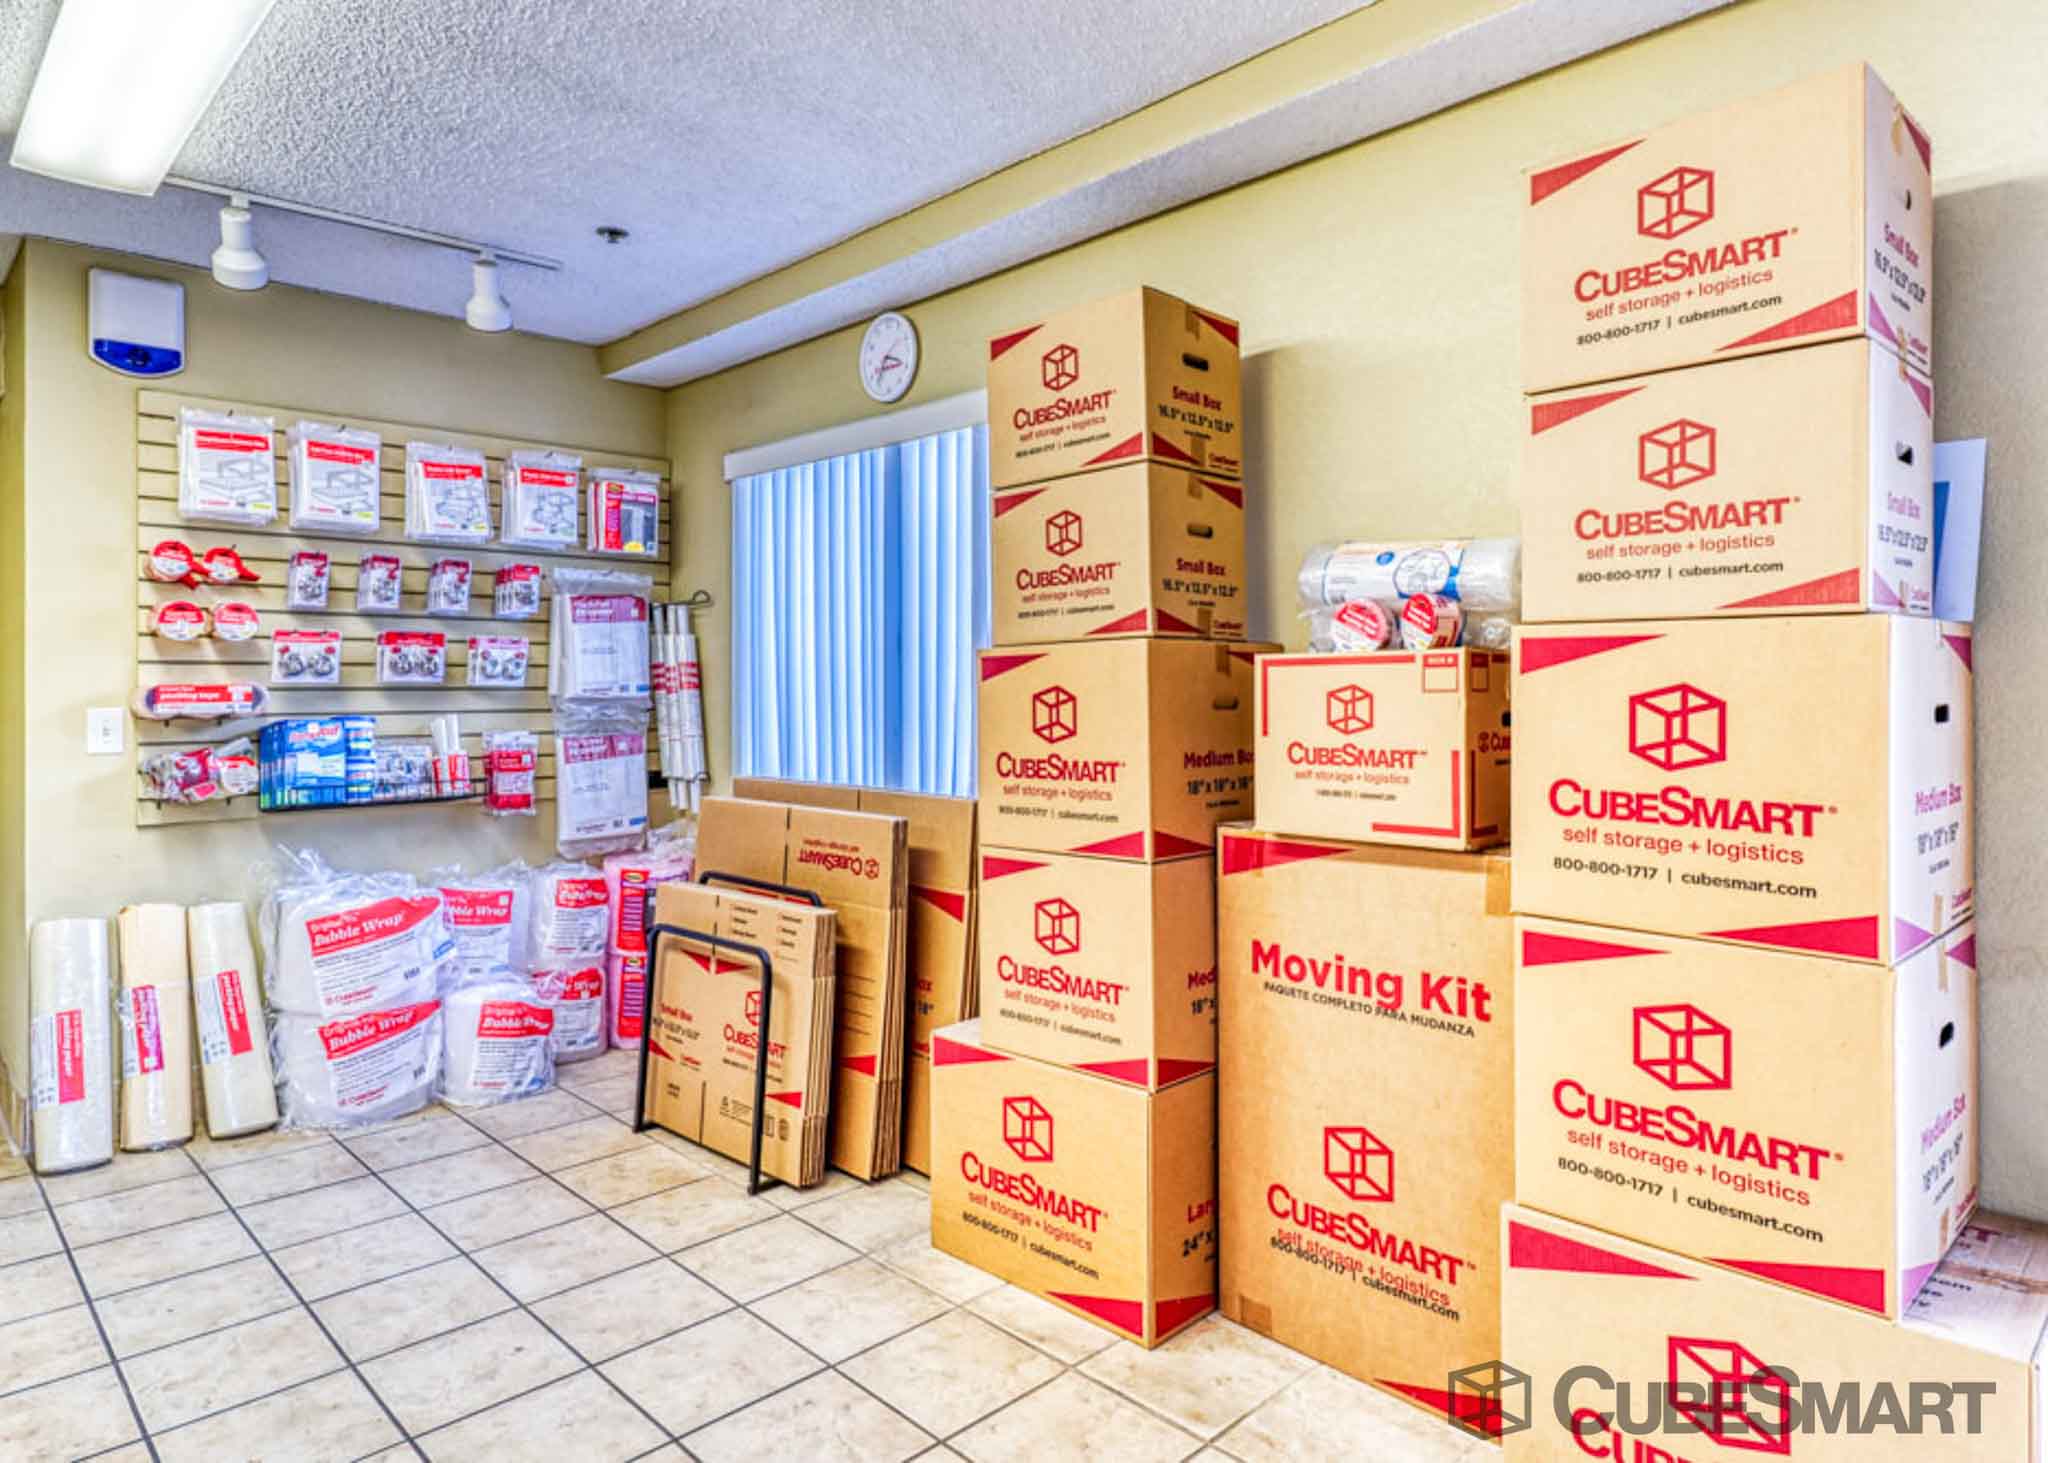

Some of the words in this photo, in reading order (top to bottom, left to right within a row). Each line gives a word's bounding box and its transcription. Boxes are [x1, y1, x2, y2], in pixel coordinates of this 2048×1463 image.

[1586, 293, 1614, 321] self
[1618, 287, 1680, 317] storage
[1699, 268, 1773, 298] logistics
[1577, 318, 1660, 345] 800-800-1717
[1678, 294, 1782, 325] cubesmart.com
[1172, 385, 1200, 405] Small
[1176, 557, 1204, 573] Small
[1586, 544, 1614, 560] self
[1618, 540, 1682, 560] storage
[1699, 533, 1775, 556] logistics
[1577, 567, 1661, 583] 800-800-1717
[1679, 560, 1783, 578] cubesmart.com
[1021, 785, 1059, 801] storage
[1069, 786, 1112, 803] logistics
[1563, 826, 1598, 844] self
[1603, 830, 1683, 854] storage
[1705, 838, 1804, 866] logistics
[1553, 856, 1657, 881] 800-800-1717
[1681, 870, 1817, 899] cubesmart.com
[315, 925, 360, 946] Bubble
[362, 911, 404, 932] Wrap
[1251, 939, 1404, 1011] Moving
[1420, 971, 1492, 1023] Kit
[1023, 993, 1060, 1011] storage
[1071, 1003, 1116, 1023] logistics
[1263, 980, 1310, 1001] PAQUETE
[1312, 992, 1373, 1016] COMPLETO
[1375, 1006, 1408, 1023] PARA
[1410, 1015, 1475, 1038] MUDANZA
[330, 1022, 376, 1050] Bubble
[1567, 1127, 1602, 1151] self
[1608, 1138, 1688, 1174] storage
[1712, 1167, 1811, 1207] logistics
[1557, 1156, 1663, 1197] 800-800-1717
[1687, 1194, 1824, 1244] cubesmart.com
[991, 1199, 1032, 1226] storage
[1043, 1219, 1093, 1252] logistics
[1306, 1236, 1363, 1272] storage
[1379, 1266, 1451, 1307] logistics
[1361, 1275, 1460, 1322] cubesmart.com
